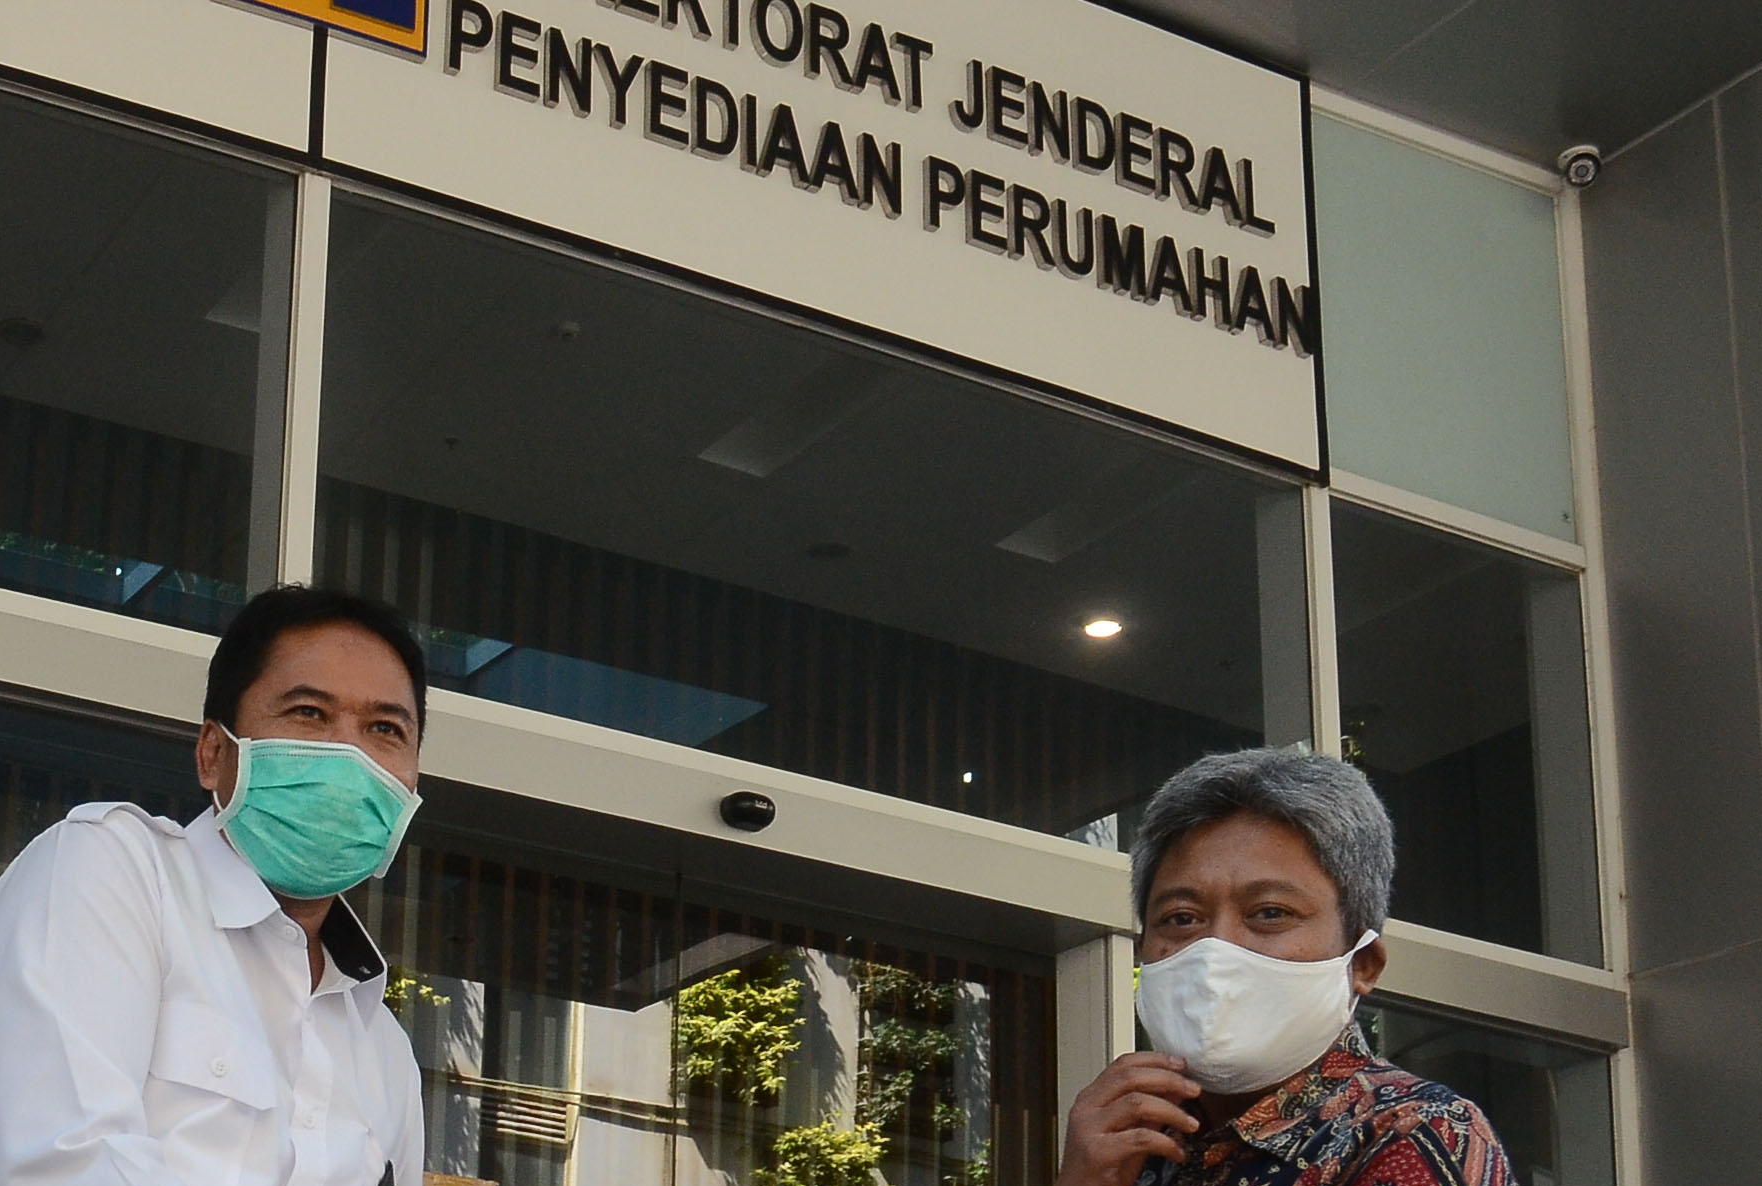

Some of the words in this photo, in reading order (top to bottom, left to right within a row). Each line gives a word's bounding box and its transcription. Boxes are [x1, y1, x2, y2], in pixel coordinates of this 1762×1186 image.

[444, 0, 902, 219] PENYEDIAAN
[923, 155, 1314, 358] PERUMAHAN
[949, 59, 1275, 238] JENDERAL
